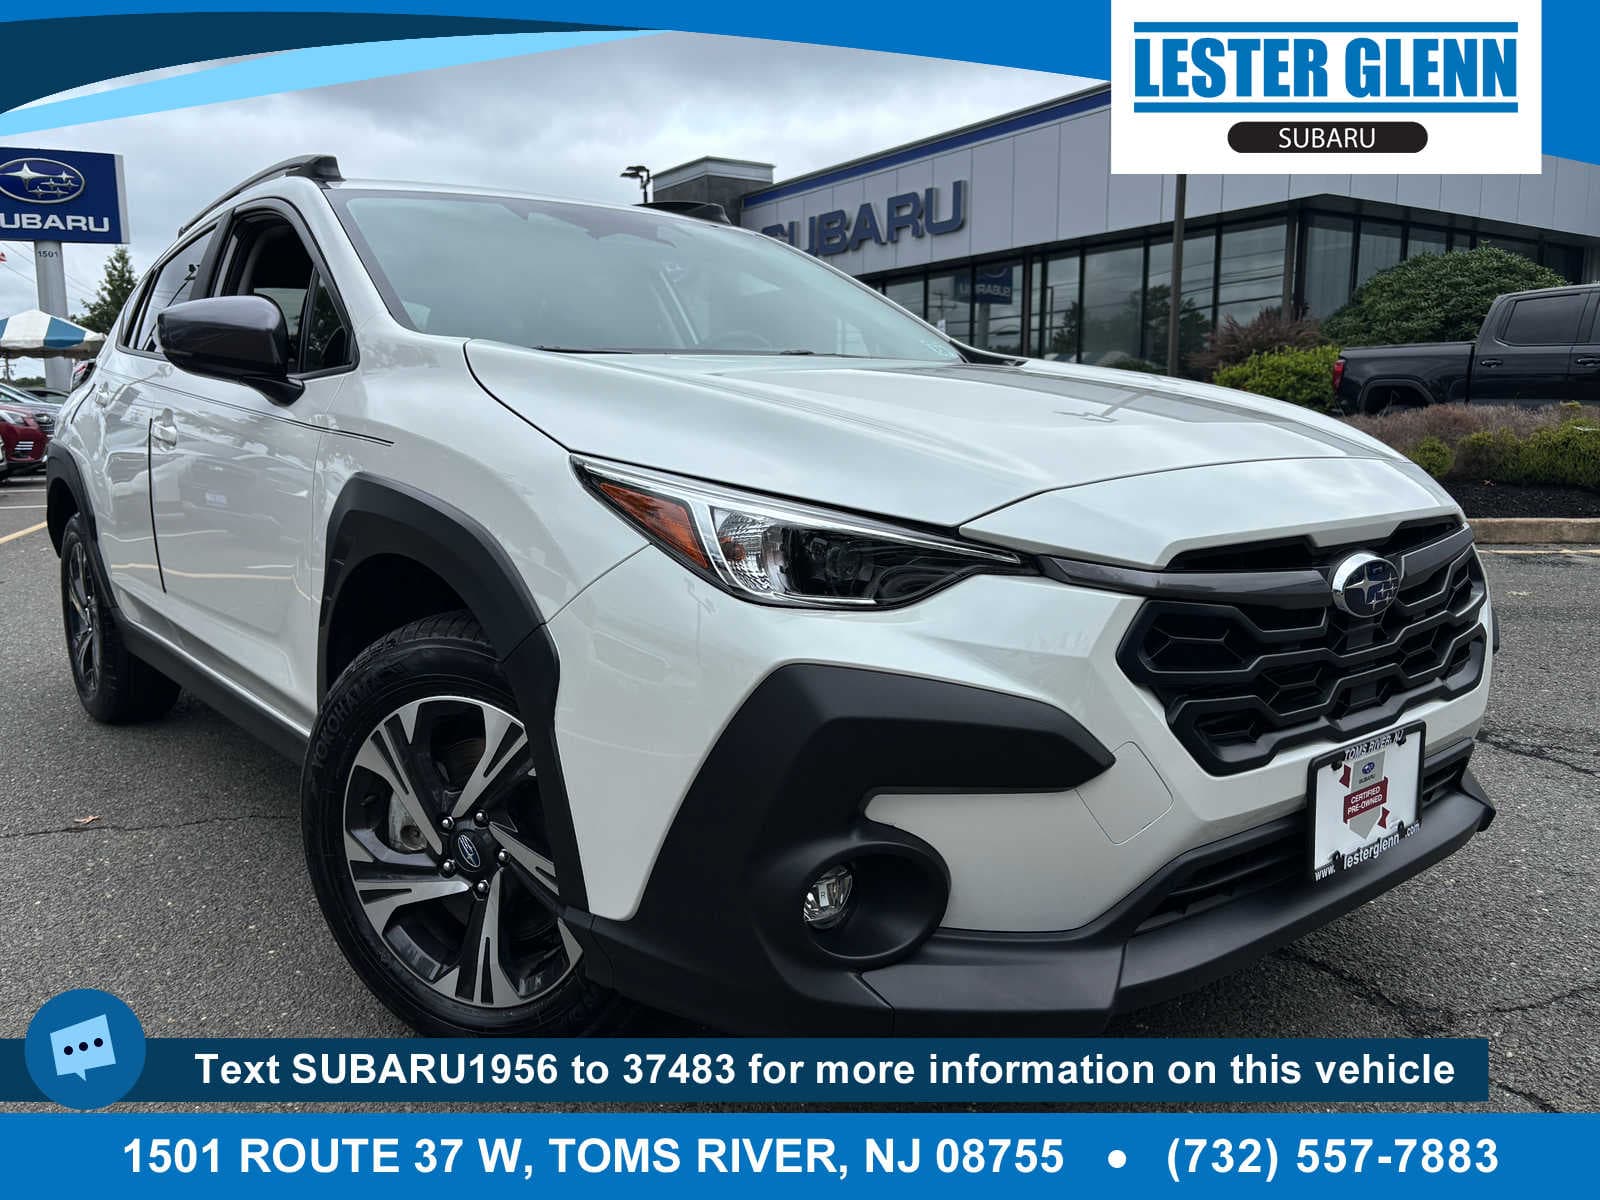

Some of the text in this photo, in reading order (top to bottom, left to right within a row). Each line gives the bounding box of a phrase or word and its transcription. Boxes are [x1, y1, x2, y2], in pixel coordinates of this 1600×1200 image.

[38, 250, 58, 258] 1501
[1345, 743, 1368, 760] TOMS
[1351, 786, 1381, 804] CERTIFIED
[1347, 794, 1383, 815] PRE-OWNED
[1343, 833, 1400, 870] lesterglenn
